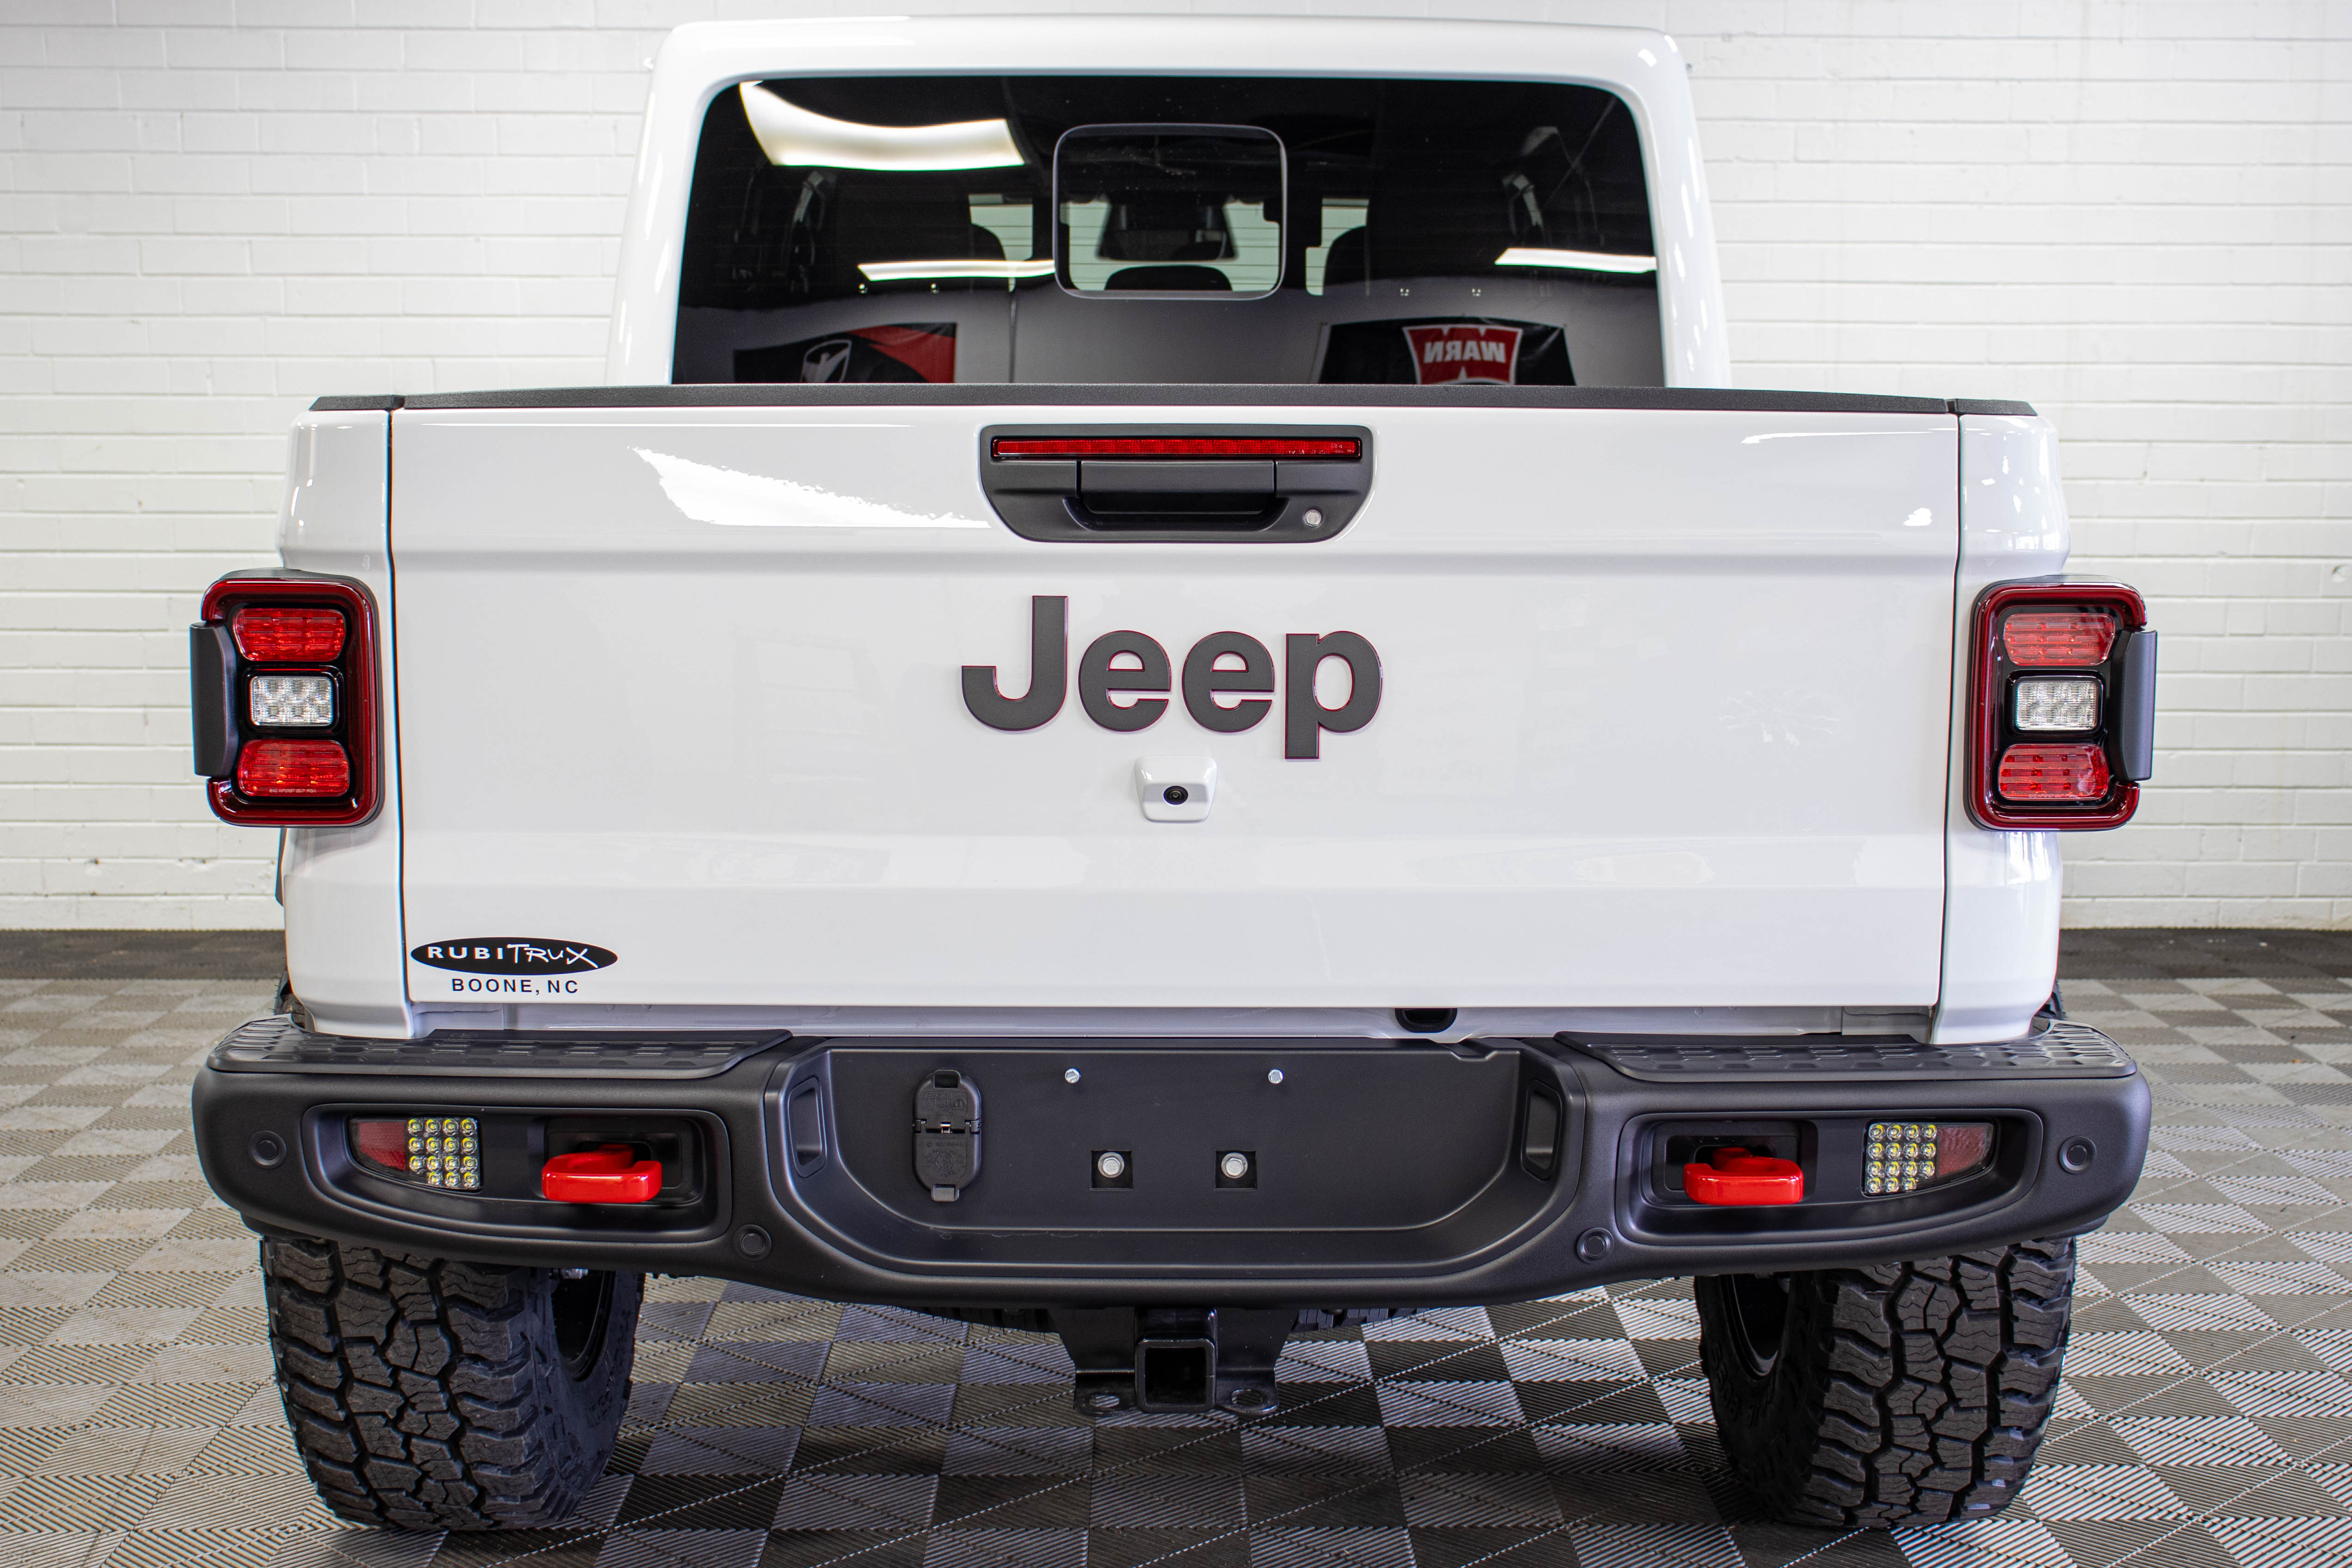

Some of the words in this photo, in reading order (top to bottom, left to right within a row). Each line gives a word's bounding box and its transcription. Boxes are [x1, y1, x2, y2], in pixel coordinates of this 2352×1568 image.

[961, 595, 1383, 759] Jeep
[451, 978, 539, 995] BOONE,
[547, 980, 578, 993] NC
